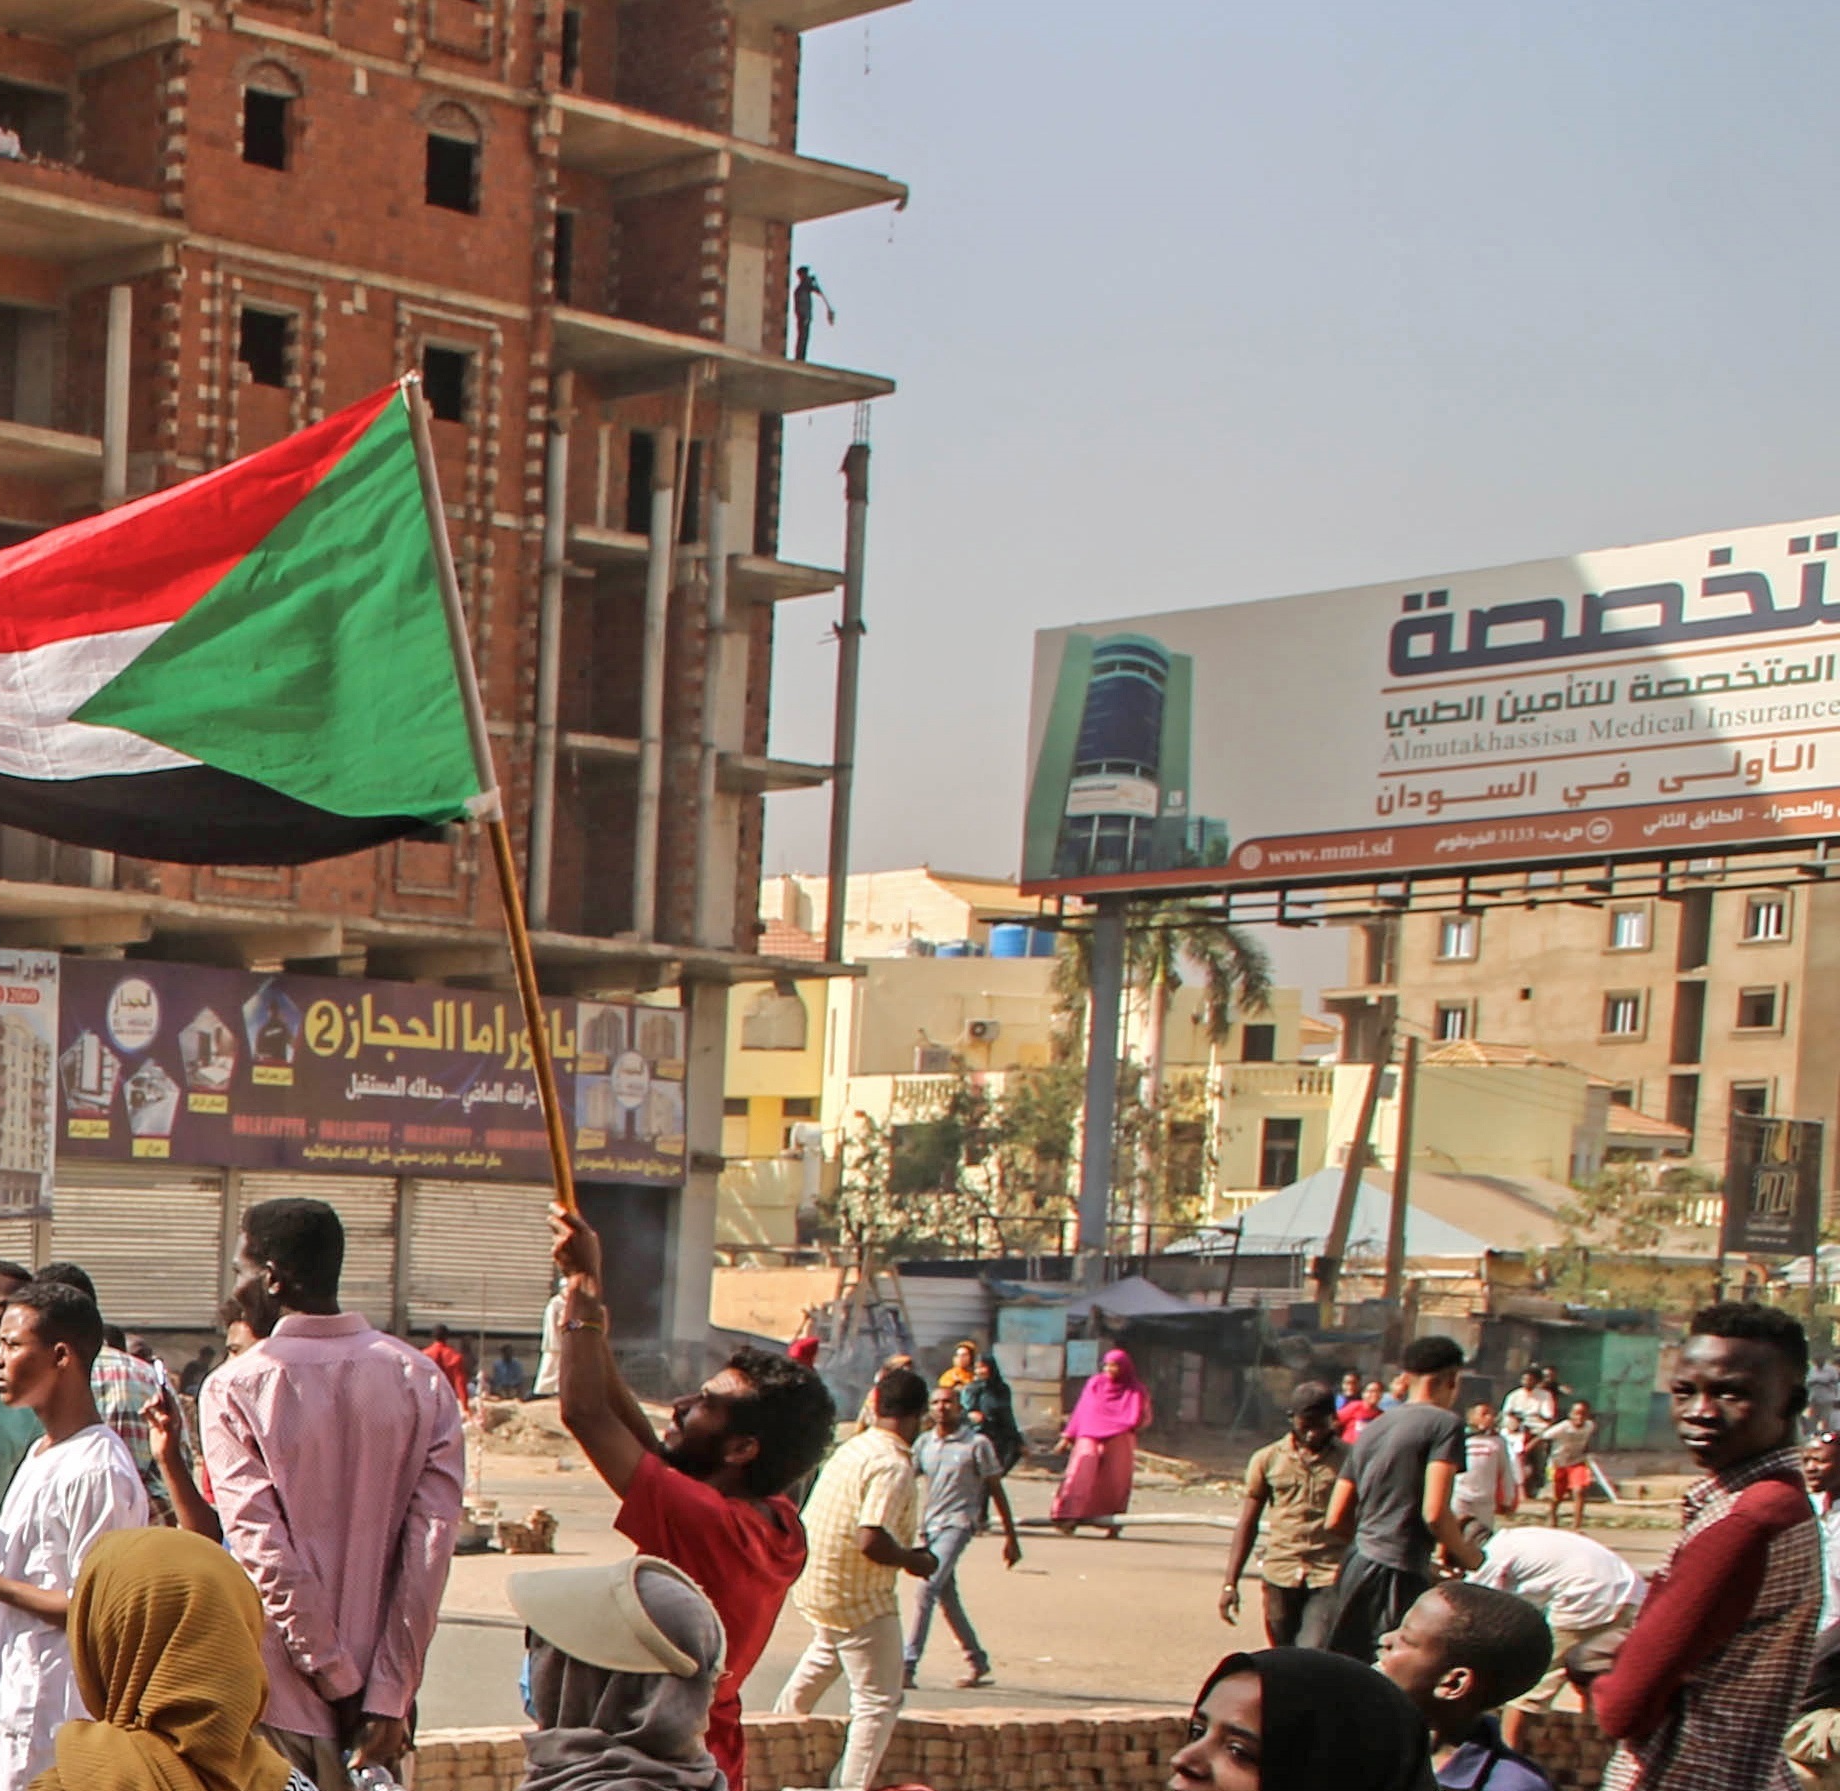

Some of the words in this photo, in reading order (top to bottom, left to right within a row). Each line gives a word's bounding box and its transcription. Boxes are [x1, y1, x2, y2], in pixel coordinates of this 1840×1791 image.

[1496, 675, 1617, 726] للتأمين
[1629, 654, 1836, 703] المتخصصة
[1382, 724, 1578, 763] Almutakhassisa
[1588, 708, 1695, 743] Medical
[1706, 698, 1840, 729] Insurance
[1385, 695, 1485, 739] الطبي
[1562, 764, 1632, 806] في
[1659, 743, 1816, 794] الأولى
[1376, 771, 1537, 816] السودان
[1268, 836, 1394, 865] www.mmi.sd
[344, 993, 455, 1062] الحجاز
